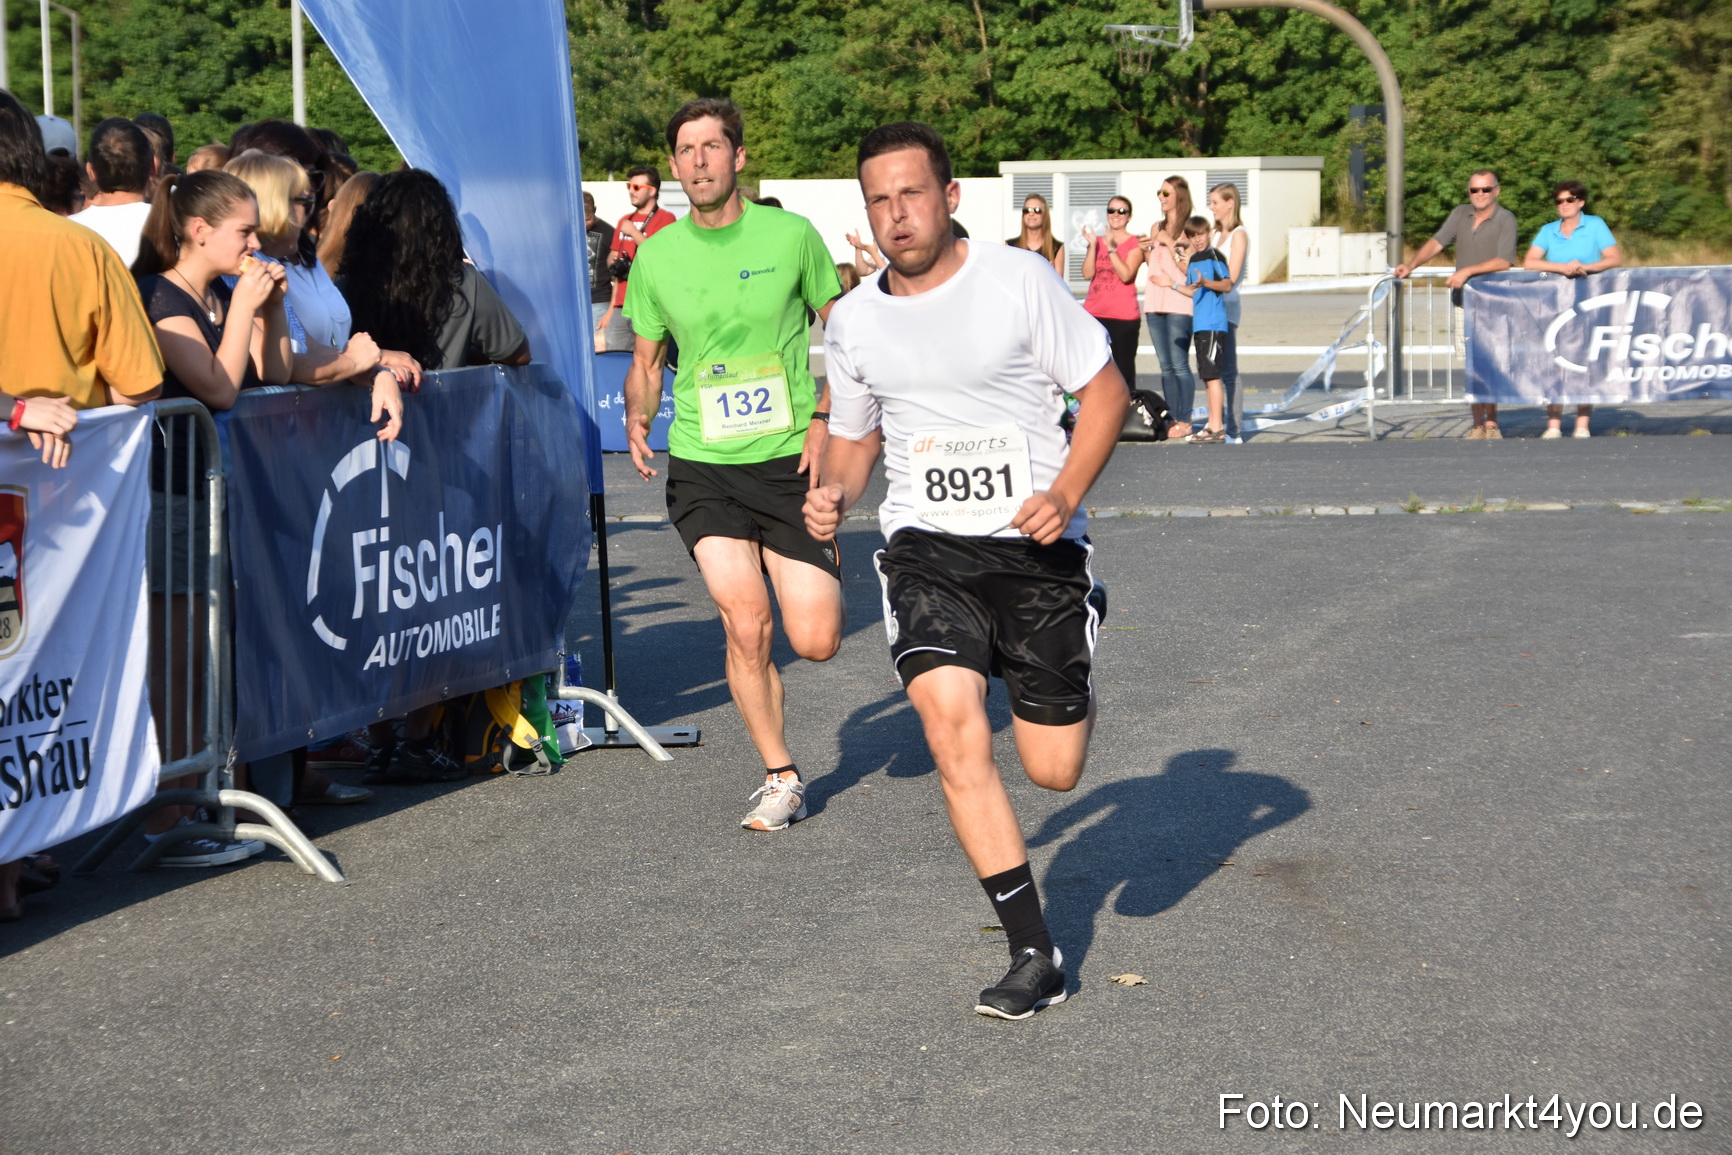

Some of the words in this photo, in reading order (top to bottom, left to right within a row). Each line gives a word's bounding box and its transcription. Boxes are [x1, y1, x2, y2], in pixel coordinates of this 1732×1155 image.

[1588, 322, 1732, 362] Fisch
[716, 387, 773, 417] 132
[914, 436, 1008, 454] df-sports
[925, 463, 1013, 502] 8931
[363, 603, 500, 671] AUTOMOBILE
